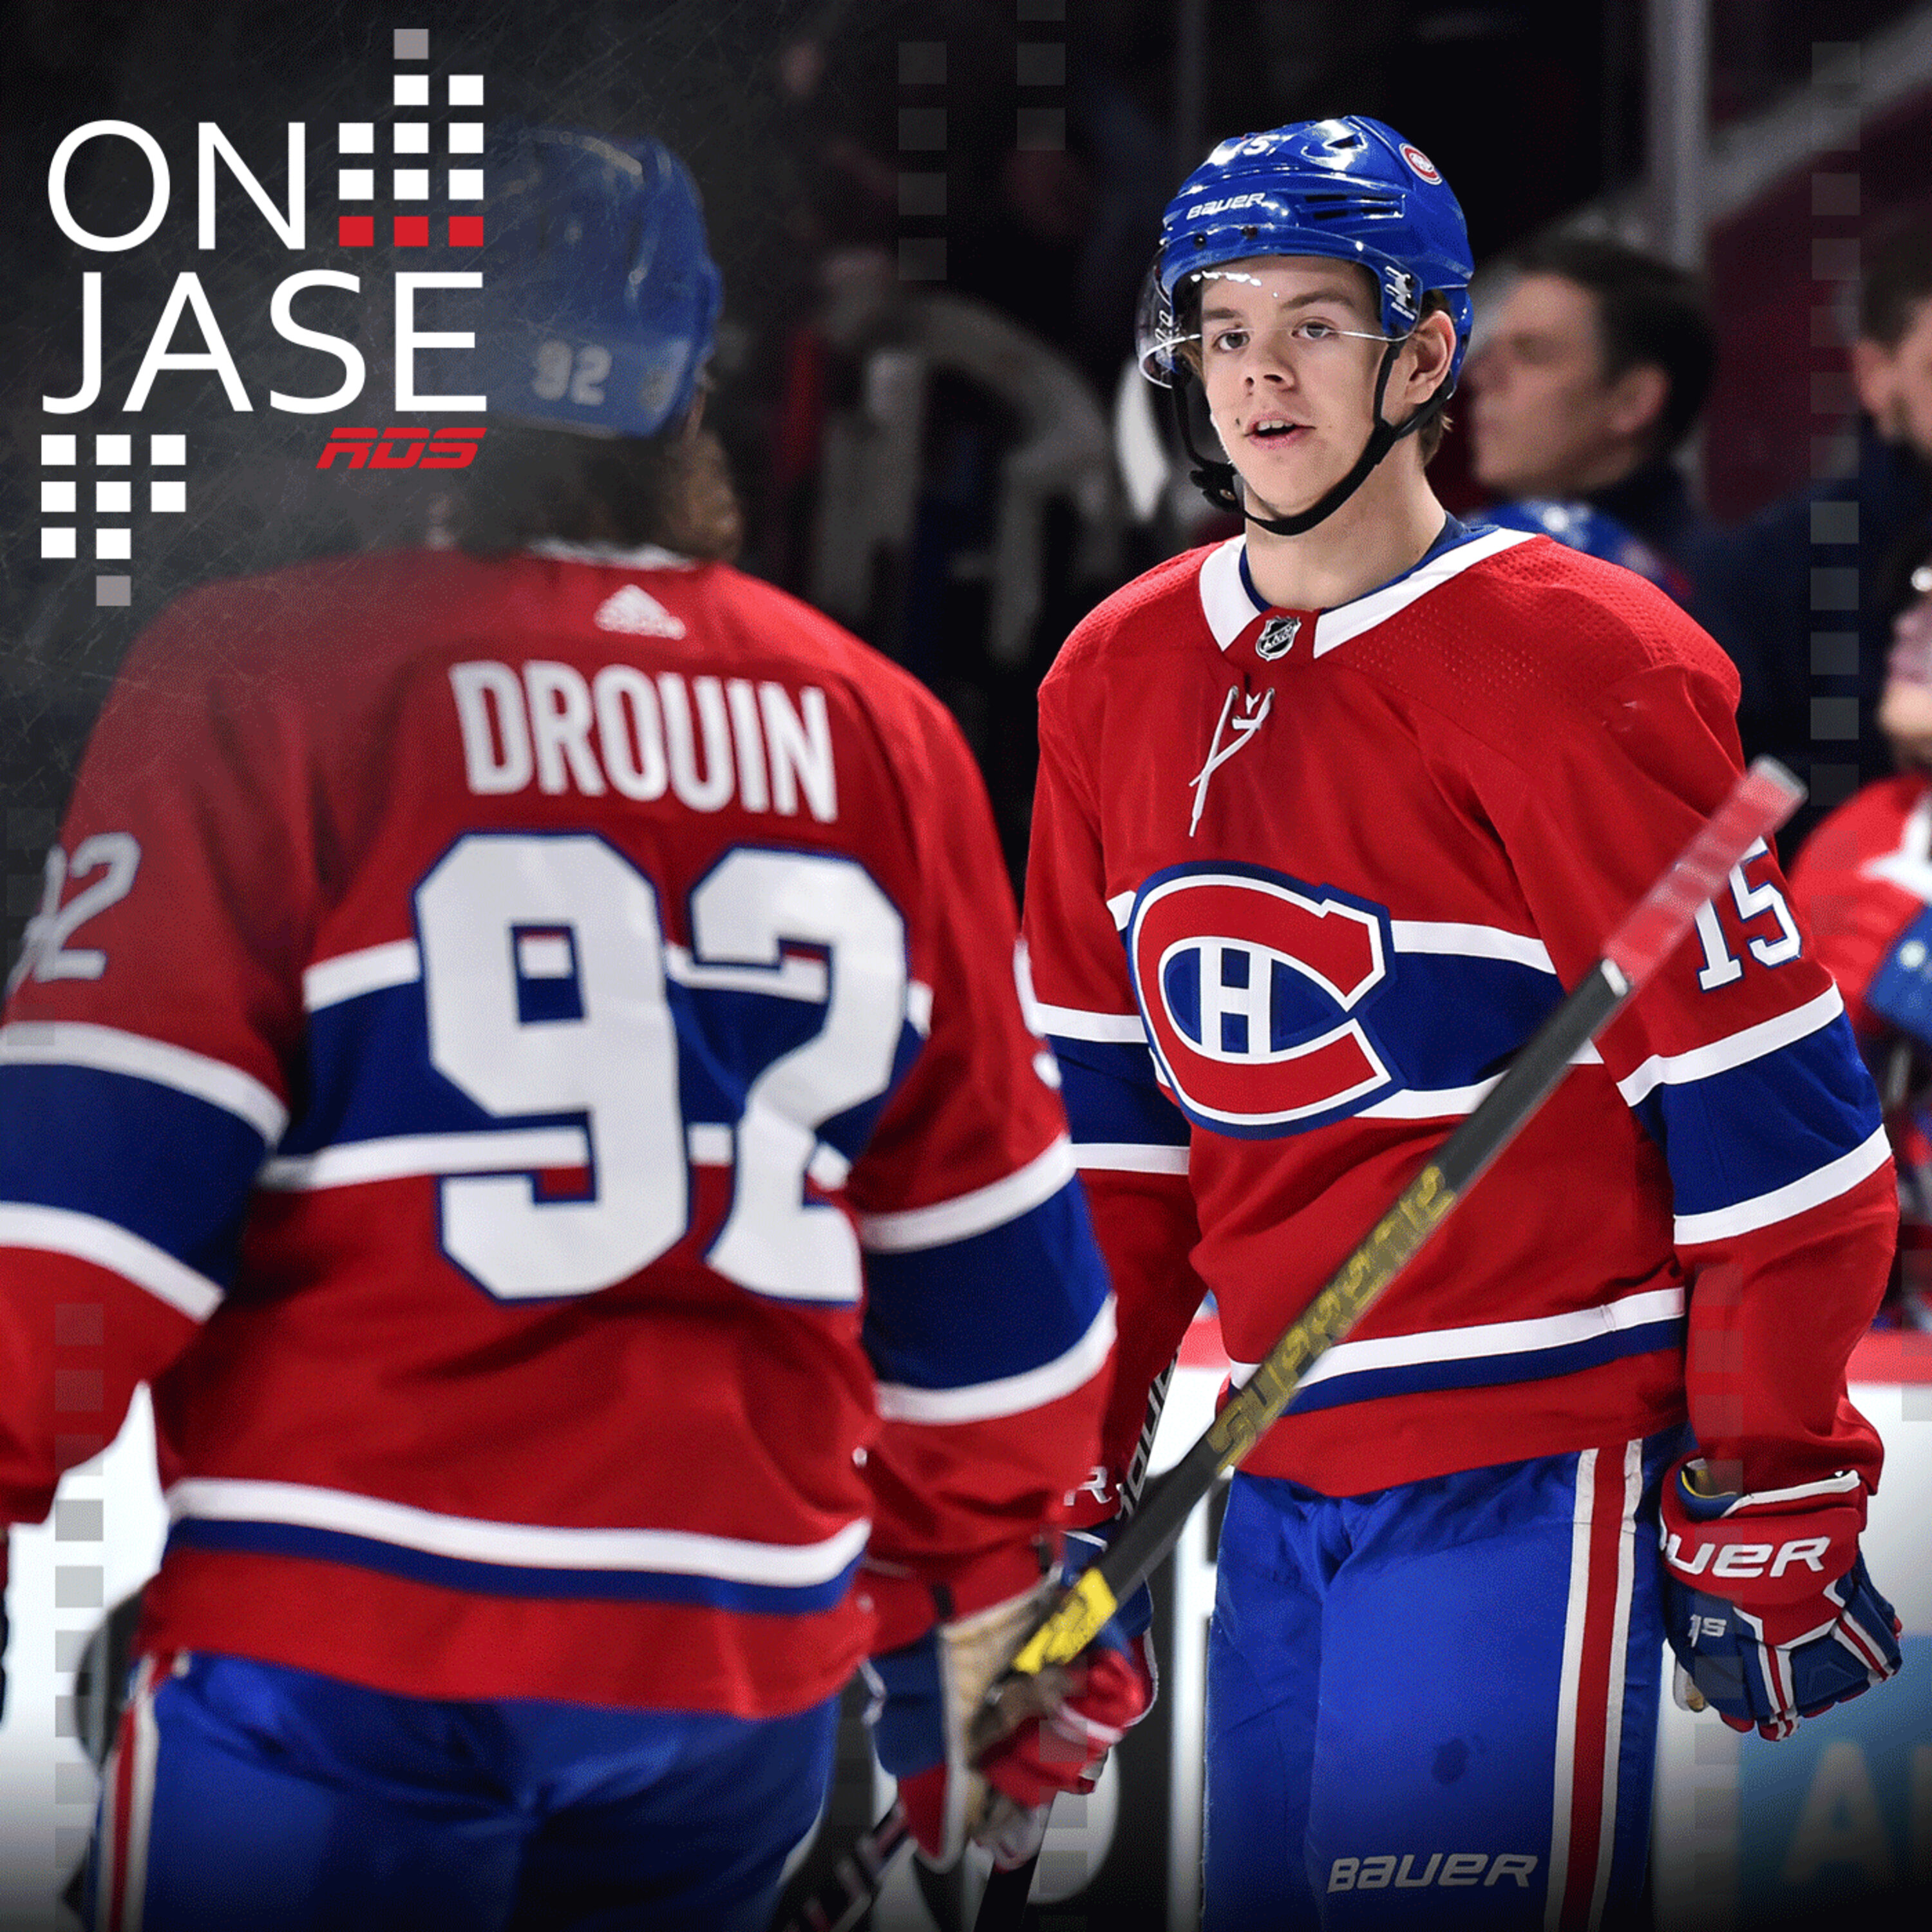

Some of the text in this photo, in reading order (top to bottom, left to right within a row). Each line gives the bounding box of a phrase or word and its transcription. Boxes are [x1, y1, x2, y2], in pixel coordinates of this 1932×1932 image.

[533, 339, 612, 406] 92
[450, 660, 838, 822] DROUIN
[1694, 835, 1803, 992] 15
[413, 831, 908, 1305] 92
